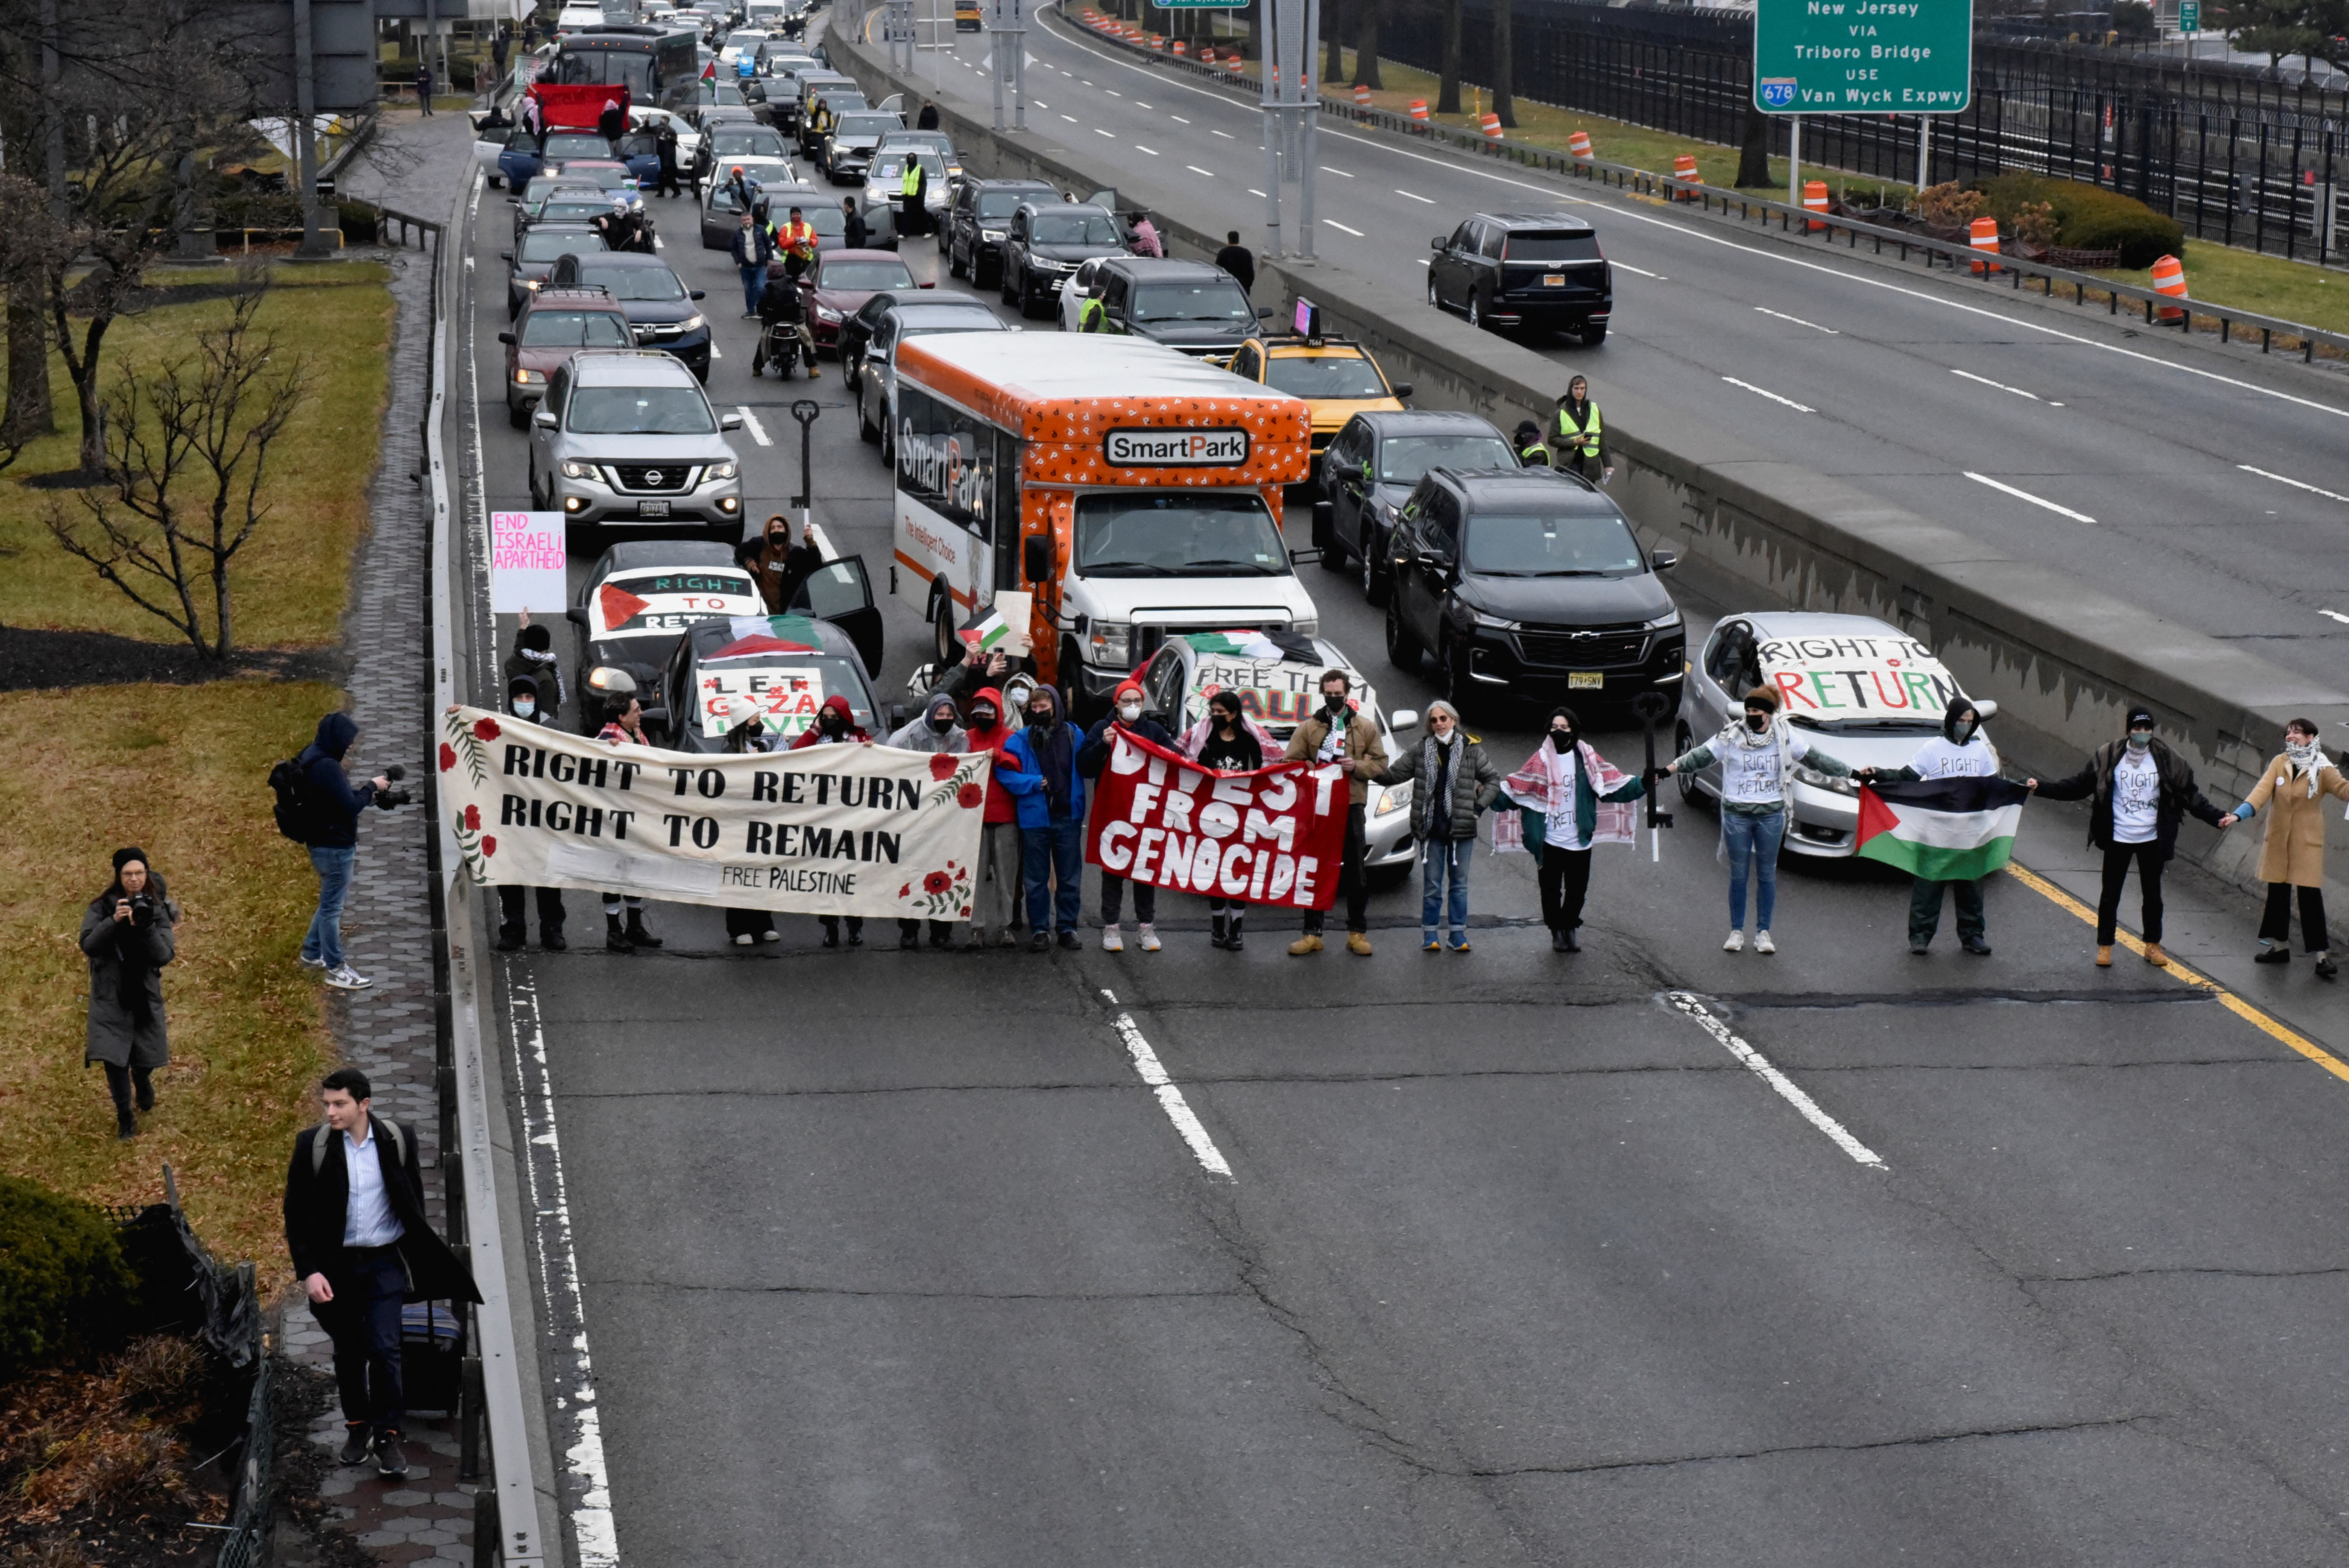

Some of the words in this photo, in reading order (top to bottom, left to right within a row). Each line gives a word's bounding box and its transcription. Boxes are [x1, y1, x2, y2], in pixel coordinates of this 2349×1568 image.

[1807, 2, 1844, 15] New
[1857, 1, 1918, 18] Jersey
[1849, 26, 1877, 37] VIA
[1795, 45, 1860, 59] Triboro
[1872, 45, 1931, 62] Bridge
[1846, 69, 1878, 80] USE
[1764, 85, 1793, 100] 678
[1802, 90, 1836, 103] Van
[1846, 89, 1892, 106] Wyck
[1903, 89, 1962, 106] Expwy
[1114, 436, 1243, 458] SmartPark
[903, 416, 984, 520] SmartPark
[495, 514, 528, 530] END
[905, 515, 914, 537] The
[915, 520, 937, 553] Intelligent
[938, 536, 955, 565] Choice
[656, 578, 742, 592] RIGHT
[682, 598, 725, 610] TO
[1759, 639, 1878, 664] RIGHT
[714, 675, 805, 694] LET
[1195, 668, 1272, 689] FREE
[1283, 670, 1370, 703] THM
[1774, 670, 1962, 711] RETURN
[1238, 687, 1315, 723] ALL
[1743, 753, 1780, 772] RIGHT
[1942, 758, 1980, 775] RIGHT
[504, 744, 641, 790] RIGHT
[668, 768, 726, 798] TO
[752, 771, 922, 811] RETURN
[2120, 770, 2158, 790] RIGHT
[2132, 788, 2144, 796] OF
[2121, 797, 2159, 815] RETUR
[1130, 783, 1296, 853] FROM
[1553, 811, 1577, 829] RETU
[501, 794, 636, 839] RIGHT
[663, 814, 720, 848] TO
[746, 820, 901, 864] REMAIN
[1099, 821, 1319, 907] GENOCIDE
[723, 866, 763, 887] FREE
[770, 867, 856, 895] PALESTINE
